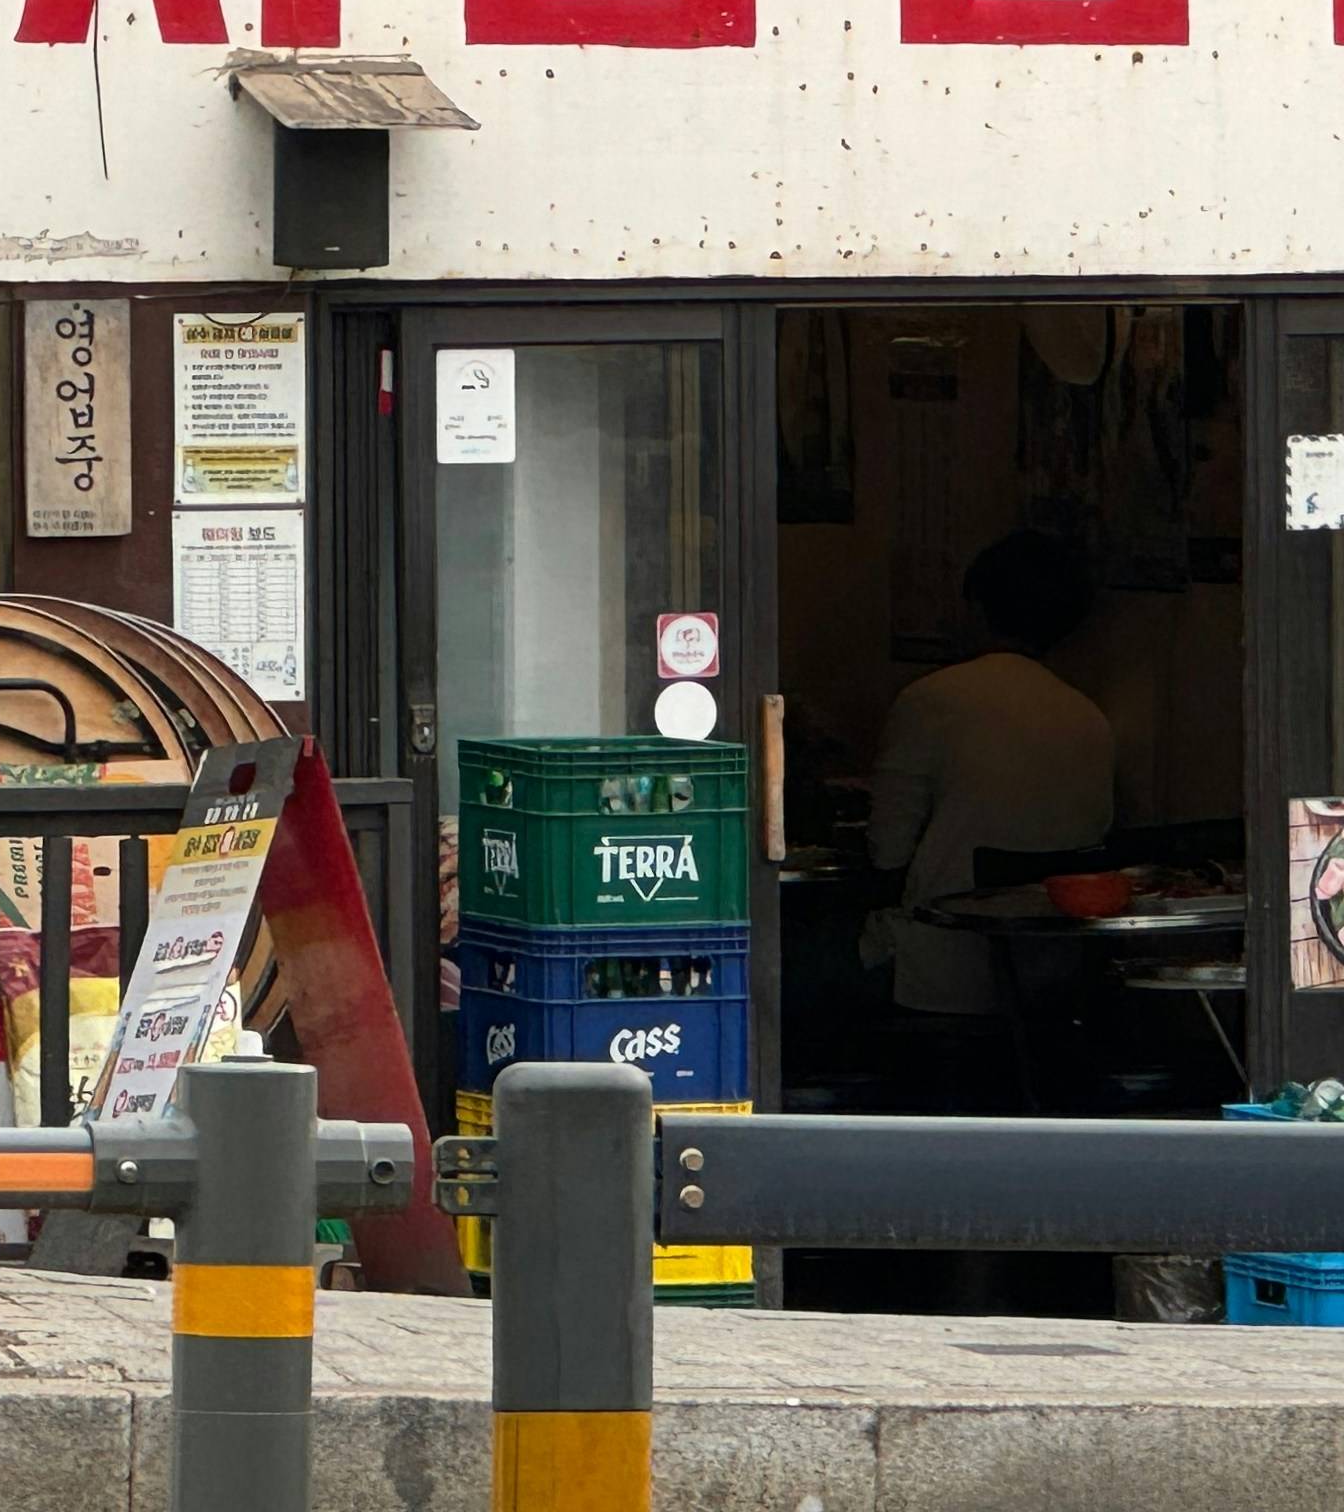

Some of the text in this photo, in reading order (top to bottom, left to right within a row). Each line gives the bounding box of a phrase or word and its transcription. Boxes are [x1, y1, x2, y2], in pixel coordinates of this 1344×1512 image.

[55, 309, 103, 493] 영업중
[594, 841, 700, 883] TERRA
[608, 1021, 682, 1064] Cass
